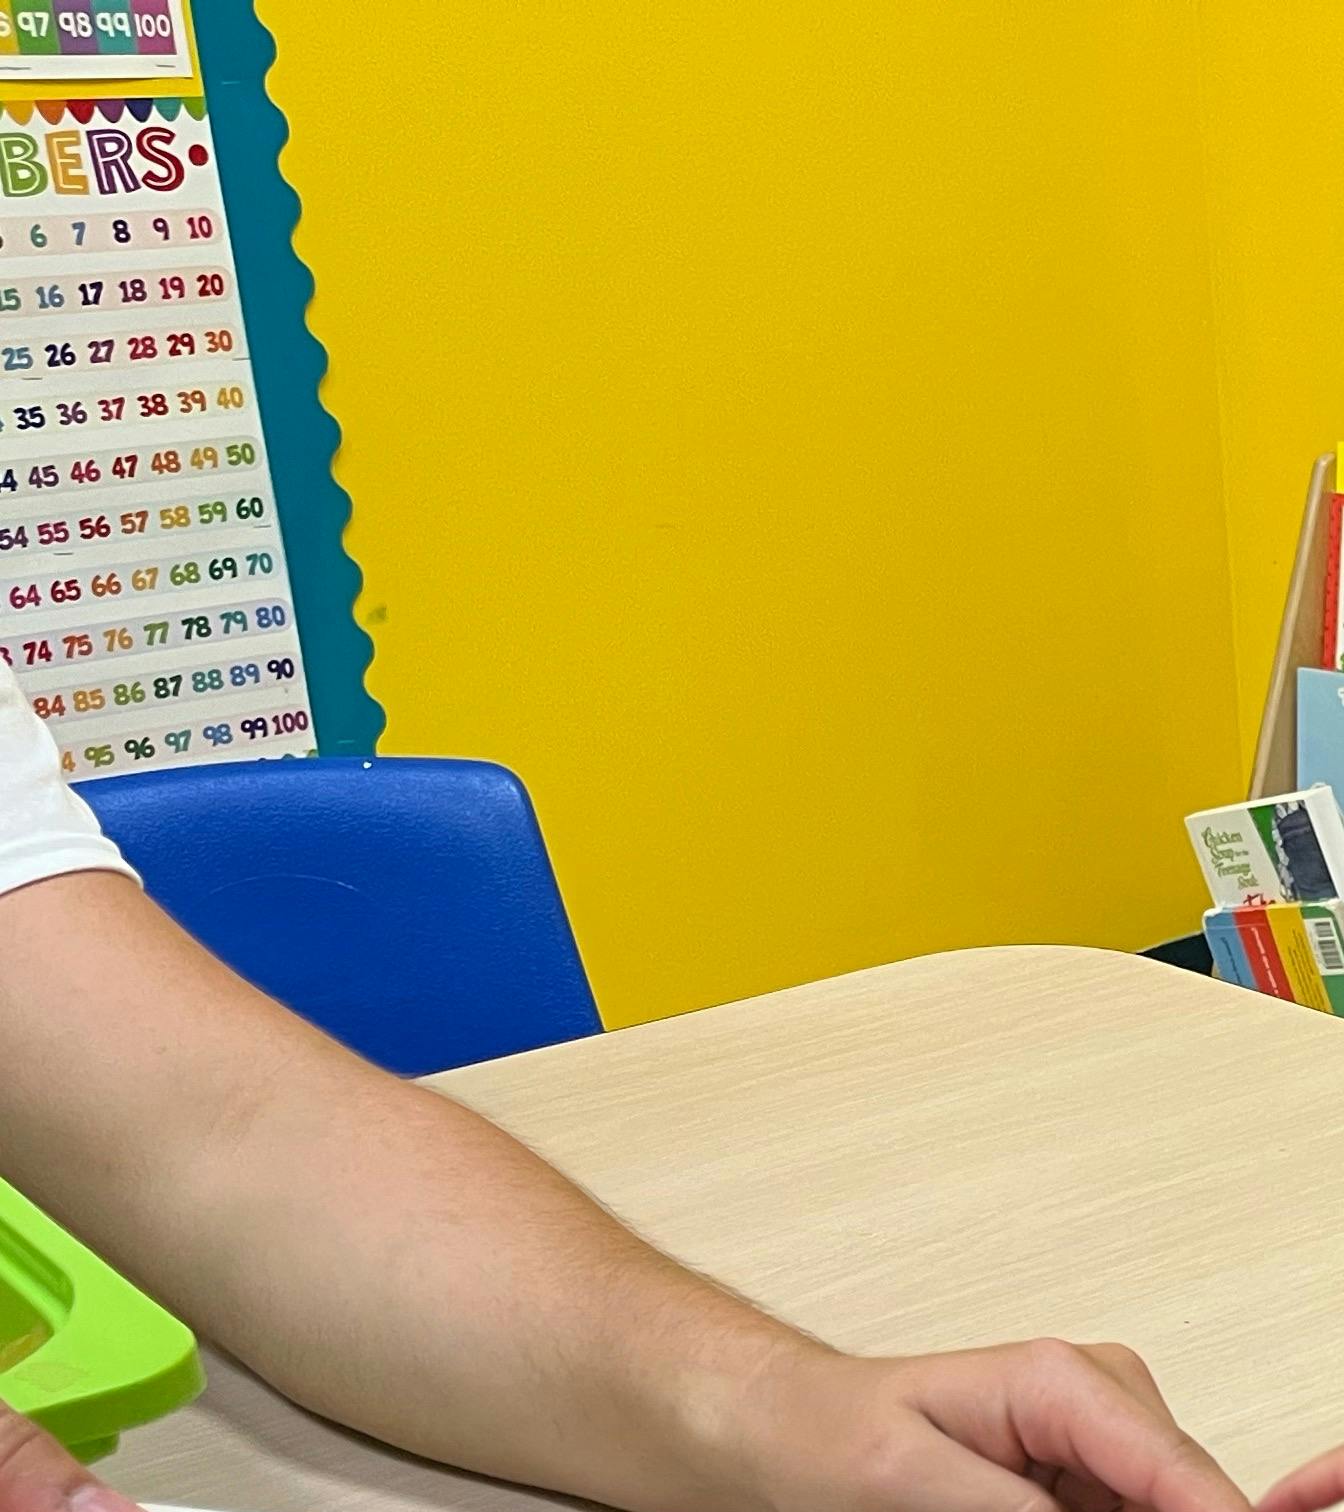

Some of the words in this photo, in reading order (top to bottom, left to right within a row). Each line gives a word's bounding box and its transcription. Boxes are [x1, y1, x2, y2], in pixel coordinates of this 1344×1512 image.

[17, 12, 49, 37] 97
[59, 11, 93, 36] 98
[96, 11, 131, 36] 99
[134, 12, 171, 37] 100
[30, 224, 47, 248] 6
[72, 221, 86, 245] 7
[112, 219, 131, 243] 8
[153, 218, 170, 240] 9
[187, 215, 213, 240] 10
[36, 285, 64, 308] 16
[79, 282, 103, 306] 17
[118, 279, 147, 302] 18
[159, 276, 185, 300] 19
[197, 273, 224, 296] 20
[4, 347, 33, 370] 25
[45, 343, 76, 367] 26
[88, 340, 115, 363] 27
[127, 336, 157, 360] 28
[166, 333, 196, 357] 29
[205, 330, 233, 353] 30
[13, 406, 46, 430] 35
[56, 402, 87, 426] 36
[97, 398, 126, 422] 37
[137, 394, 169, 417] 38
[177, 390, 207, 414] 39
[217, 387, 244, 410] 40
[28, 465, 59, 488] 45
[70, 460, 101, 484] 46
[111, 455, 138, 479] 47
[151, 451, 182, 475] 48
[190, 446, 219, 470] 49
[226, 443, 255, 466] 50
[36, 521, 70, 545] 55
[78, 516, 111, 540] 56
[120, 511, 149, 535] 57
[159, 506, 191, 529] 58
[198, 502, 228, 525] 59
[235, 497, 264, 519] 60
[9, 585, 41, 609] 64
[50, 579, 82, 603] 65
[90, 573, 122, 597] 66
[131, 567, 159, 591] 67
[169, 562, 201, 586] 68
[208, 557, 237, 581] 69
[245, 552, 273, 576] 70
[23, 641, 52, 665] 74
[62, 634, 94, 659] 75
[103, 628, 133, 652] 76
[144, 622, 170, 646] 77
[181, 616, 212, 640] 78
[219, 610, 249, 634] 79
[256, 605, 286, 628] 80
[33, 694, 66, 719] 84
[73, 688, 105, 713] 85
[113, 681, 146, 706] 86
[153, 675, 183, 699] 87
[191, 668, 224, 693] 88
[229, 663, 260, 686] 89
[267, 658, 295, 681] 90
[84, 744, 115, 768] 95
[124, 737, 155, 760] 96
[165, 730, 192, 753] 97
[202, 724, 233, 746] 98
[241, 717, 268, 739] 99
[272, 710, 309, 735] 100
